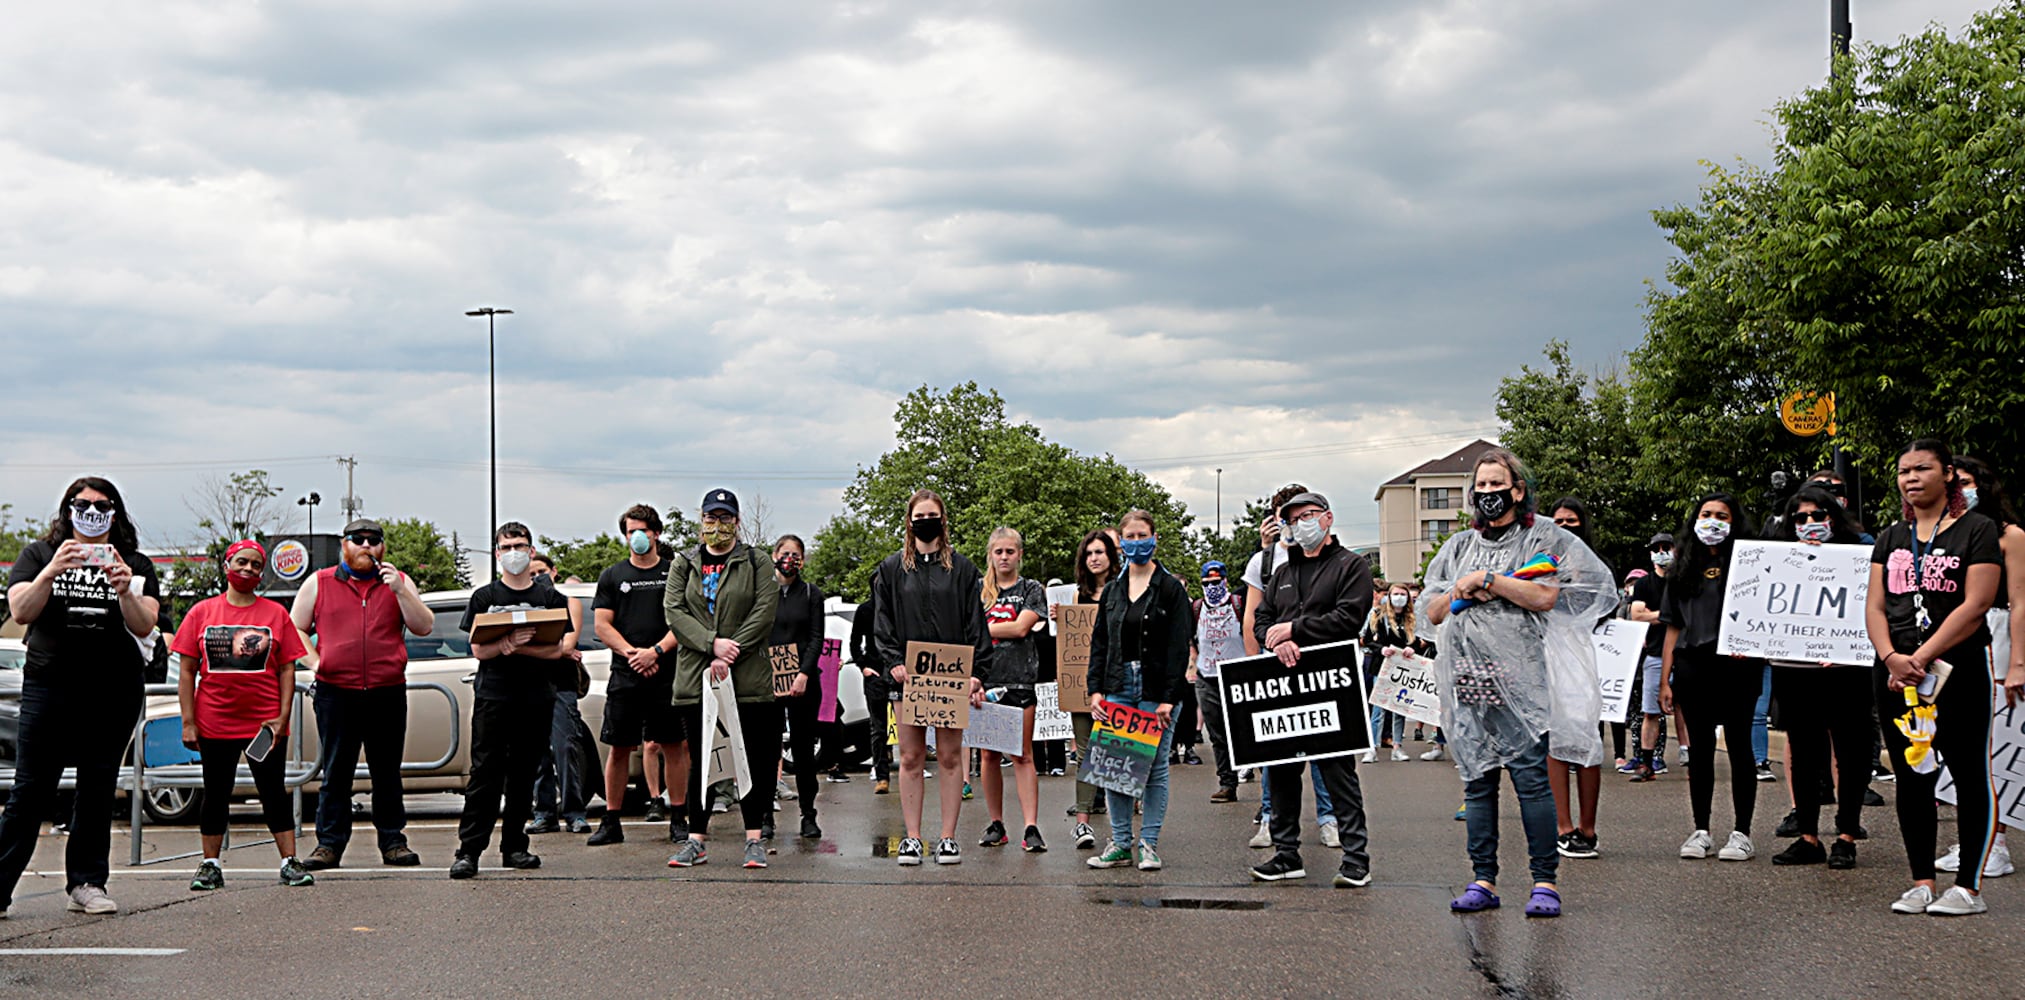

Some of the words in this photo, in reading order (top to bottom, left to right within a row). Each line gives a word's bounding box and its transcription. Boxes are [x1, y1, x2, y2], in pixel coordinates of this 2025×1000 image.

[278, 554, 303, 569] KING
[74, 583, 95, 592] Make
[1767, 582, 1848, 619] BLM
[1206, 629, 1232, 640] GREAT
[1746, 618, 1777, 635] SAY
[1784, 623, 1825, 637] THEIR
[1768, 638, 1785, 648] Eric
[1804, 641, 1834, 650] Sandra
[1804, 650, 1829, 659] Bland
[915, 651, 965, 675] Black
[911, 676, 965, 690] Futures
[1230, 675, 1292, 704] BLACK
[1298, 666, 1352, 694] LIVES
[909, 691, 955, 704] Children
[1396, 688, 1414, 705] for
[914, 705, 956, 719] Lives
[1260, 709, 1332, 736] MATTER
[1097, 727, 1135, 748] For
[1090, 745, 1136, 773] Black
[1092, 763, 1138, 786] Lives
